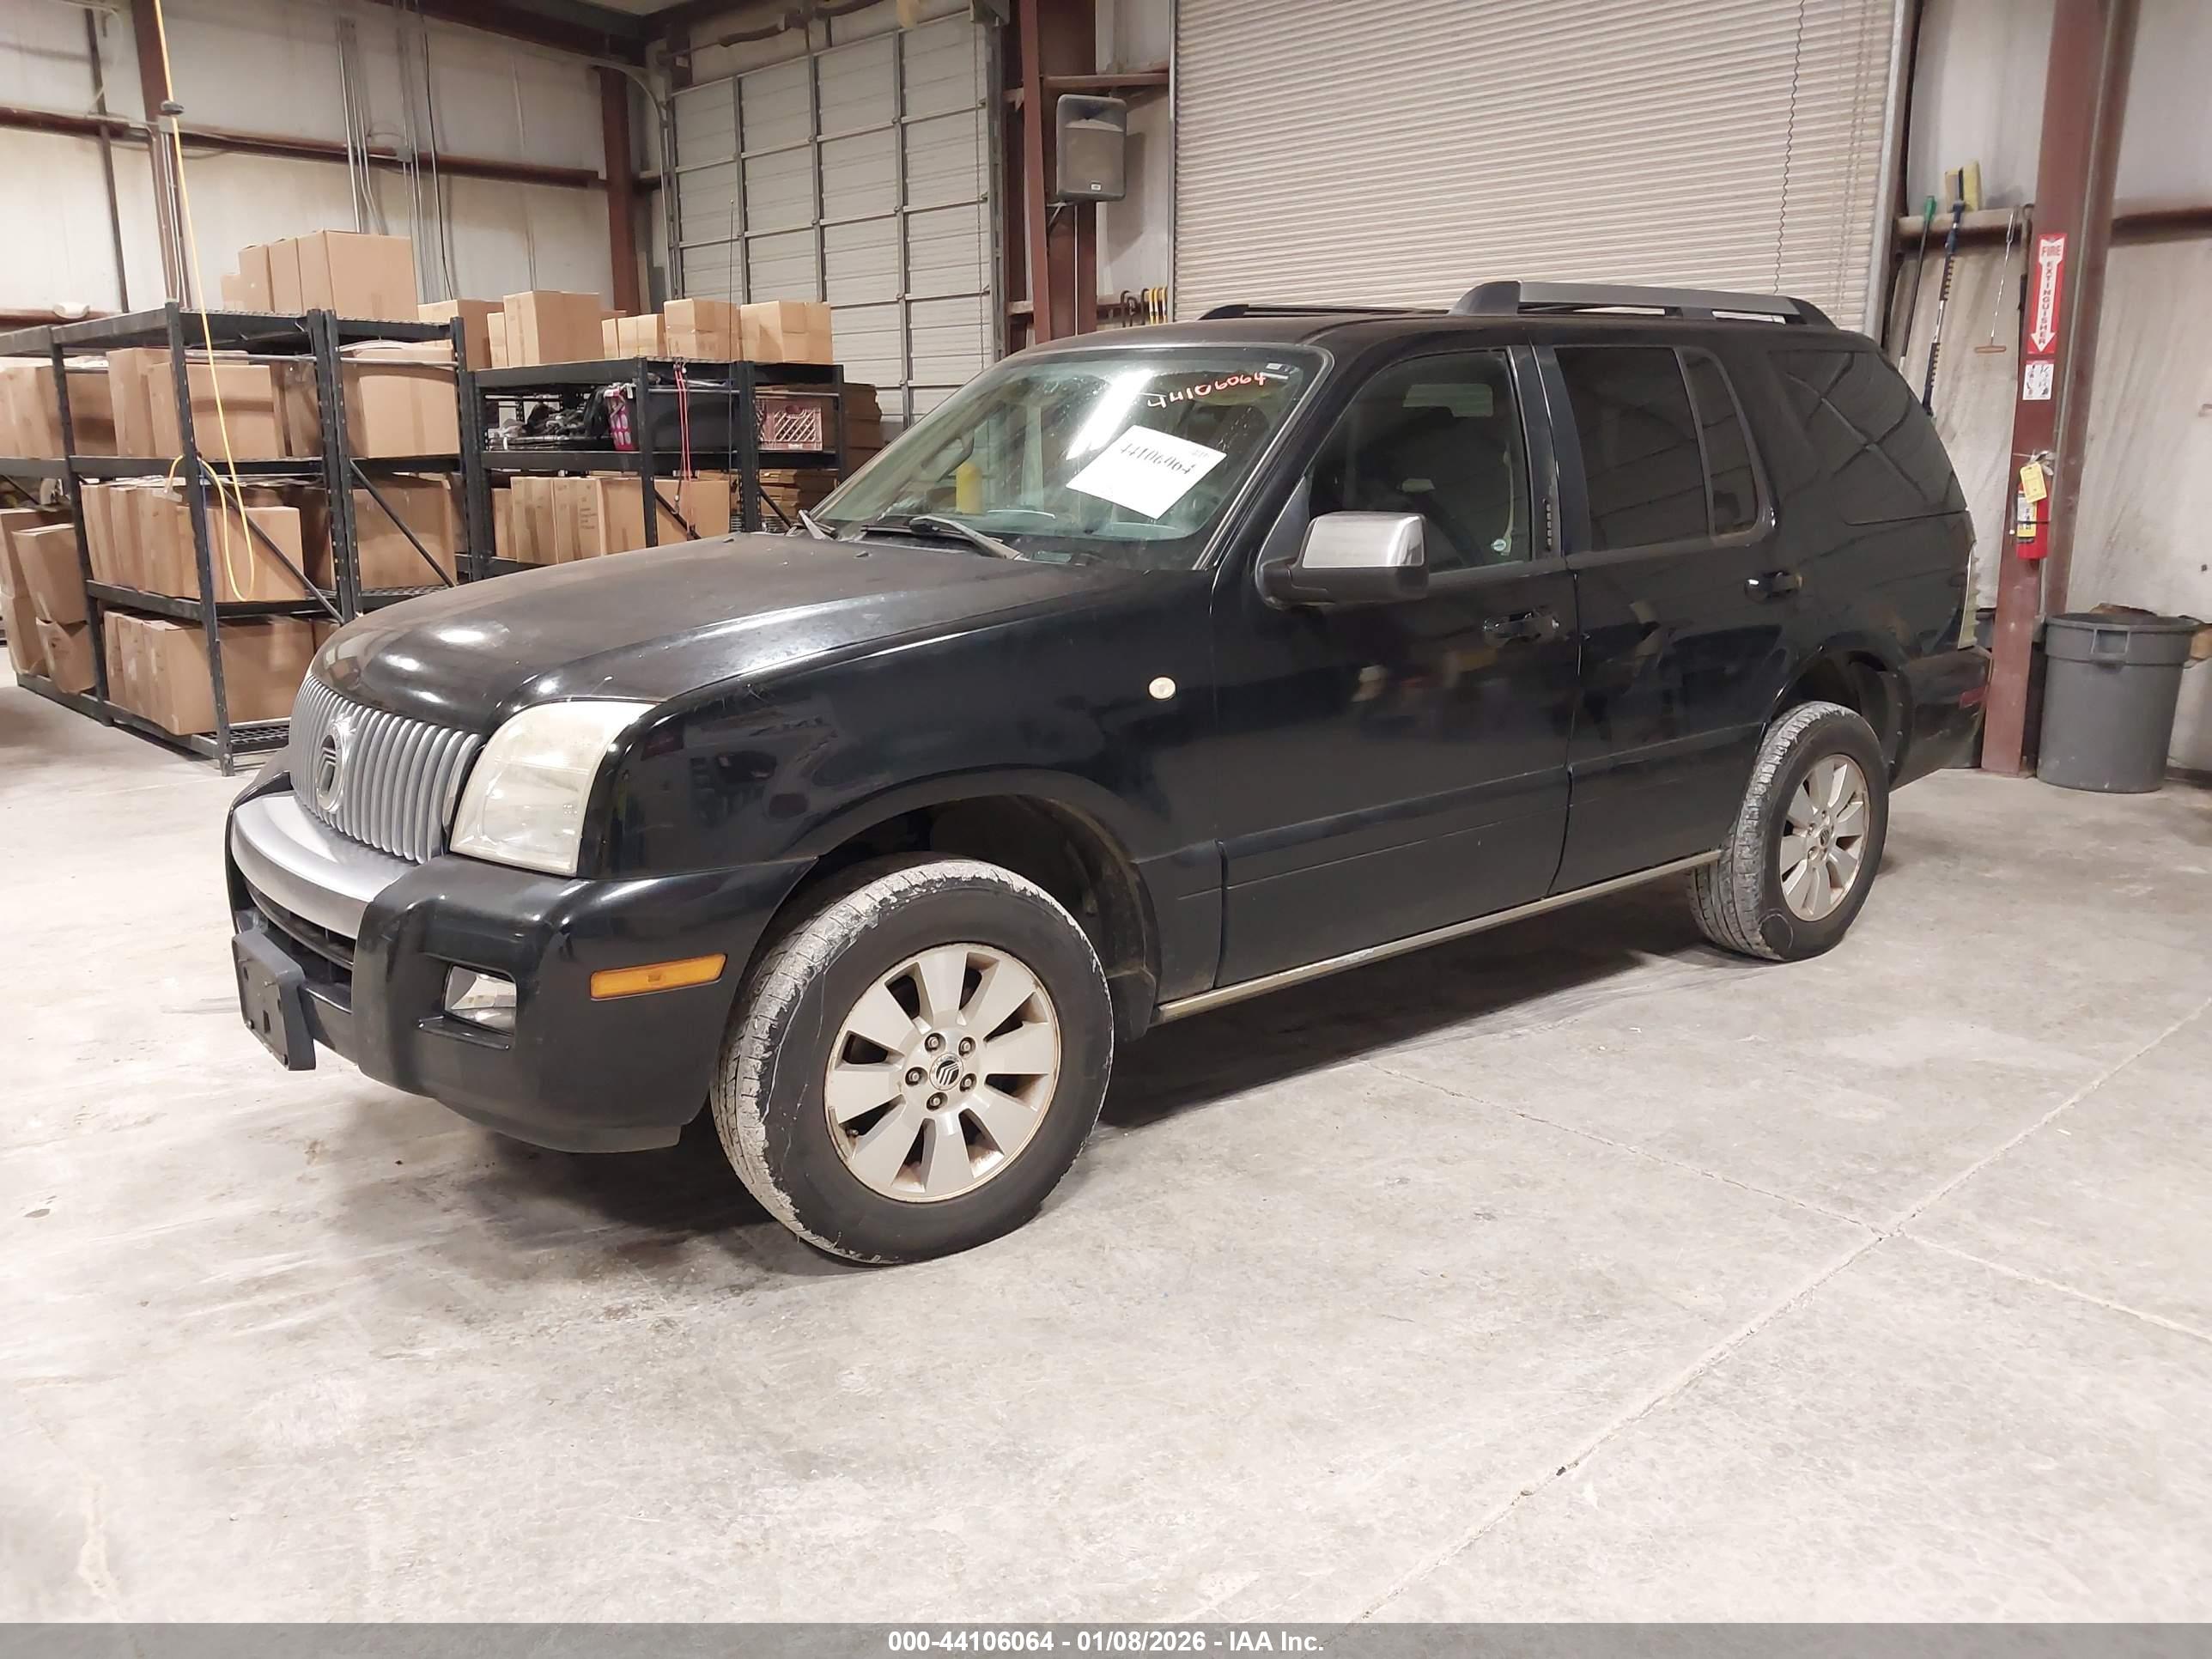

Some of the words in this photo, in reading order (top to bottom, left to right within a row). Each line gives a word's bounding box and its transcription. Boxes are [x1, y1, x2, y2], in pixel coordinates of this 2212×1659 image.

[2041, 246, 2062, 258] FIRE
[2039, 260, 2052, 345] EXTINGUISHER
[1147, 372, 1267, 408] 44106064
